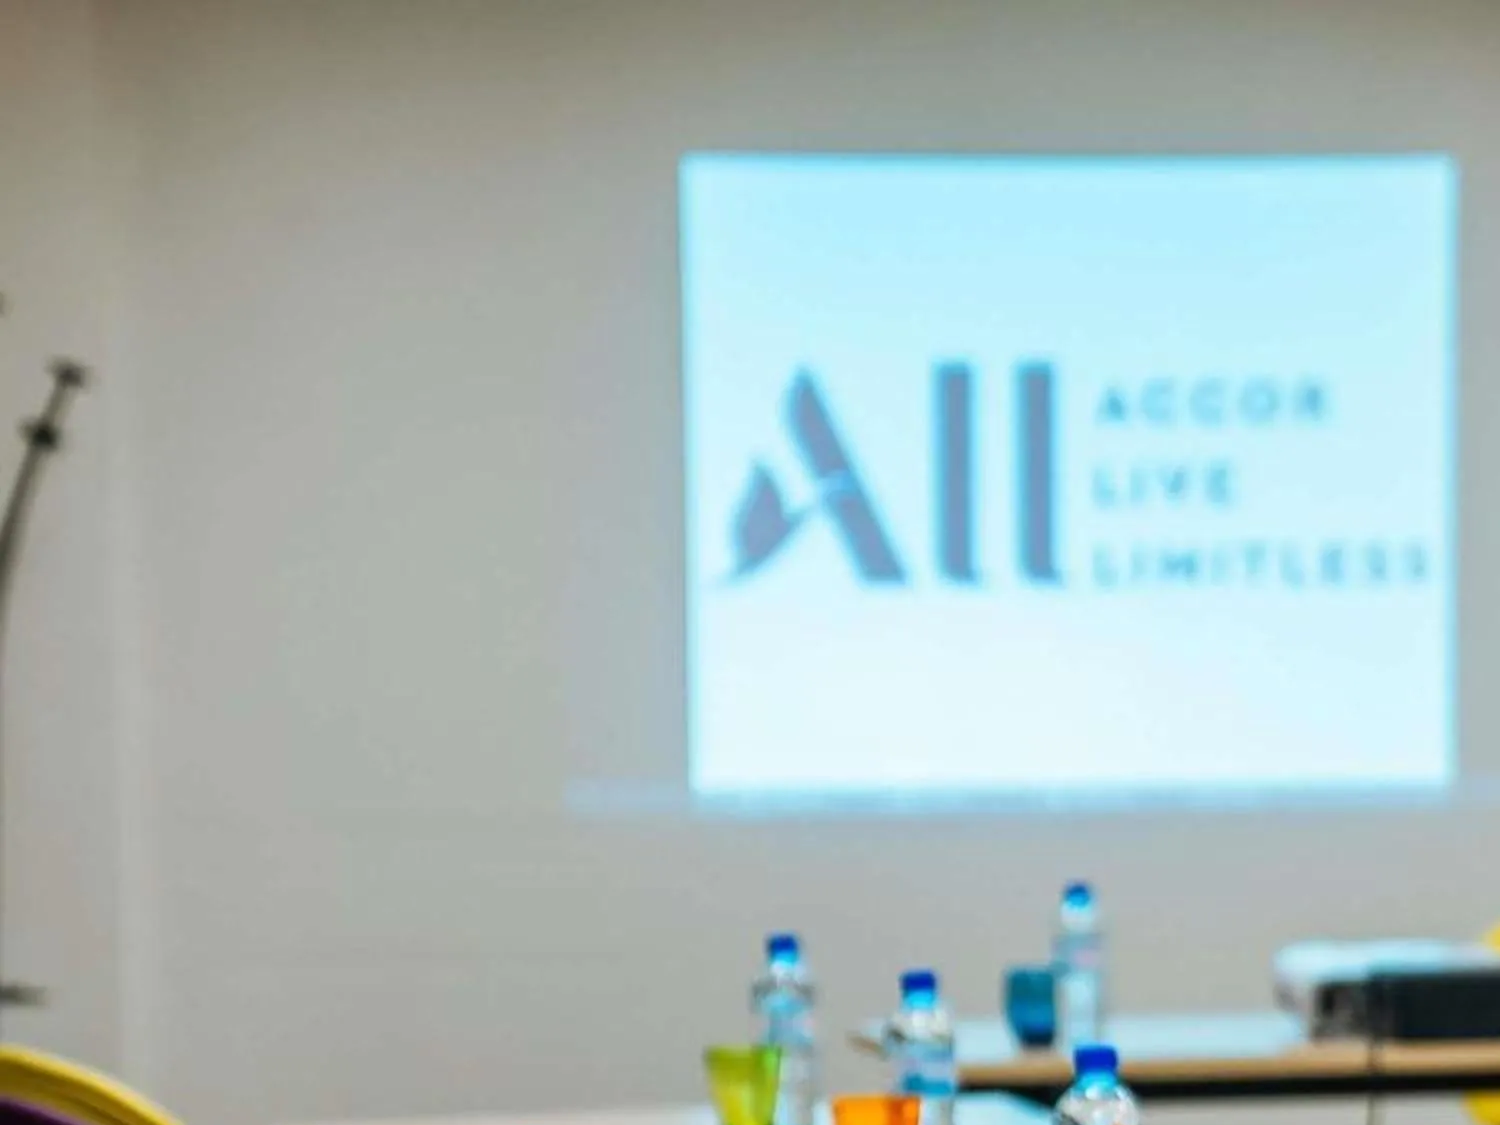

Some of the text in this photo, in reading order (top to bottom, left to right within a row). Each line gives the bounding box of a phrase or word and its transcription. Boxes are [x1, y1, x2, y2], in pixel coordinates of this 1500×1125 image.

[1096, 378, 1332, 424] ACCOR
[1092, 460, 1236, 506] LIVE
[1092, 540, 1430, 588] LIMITLESS
